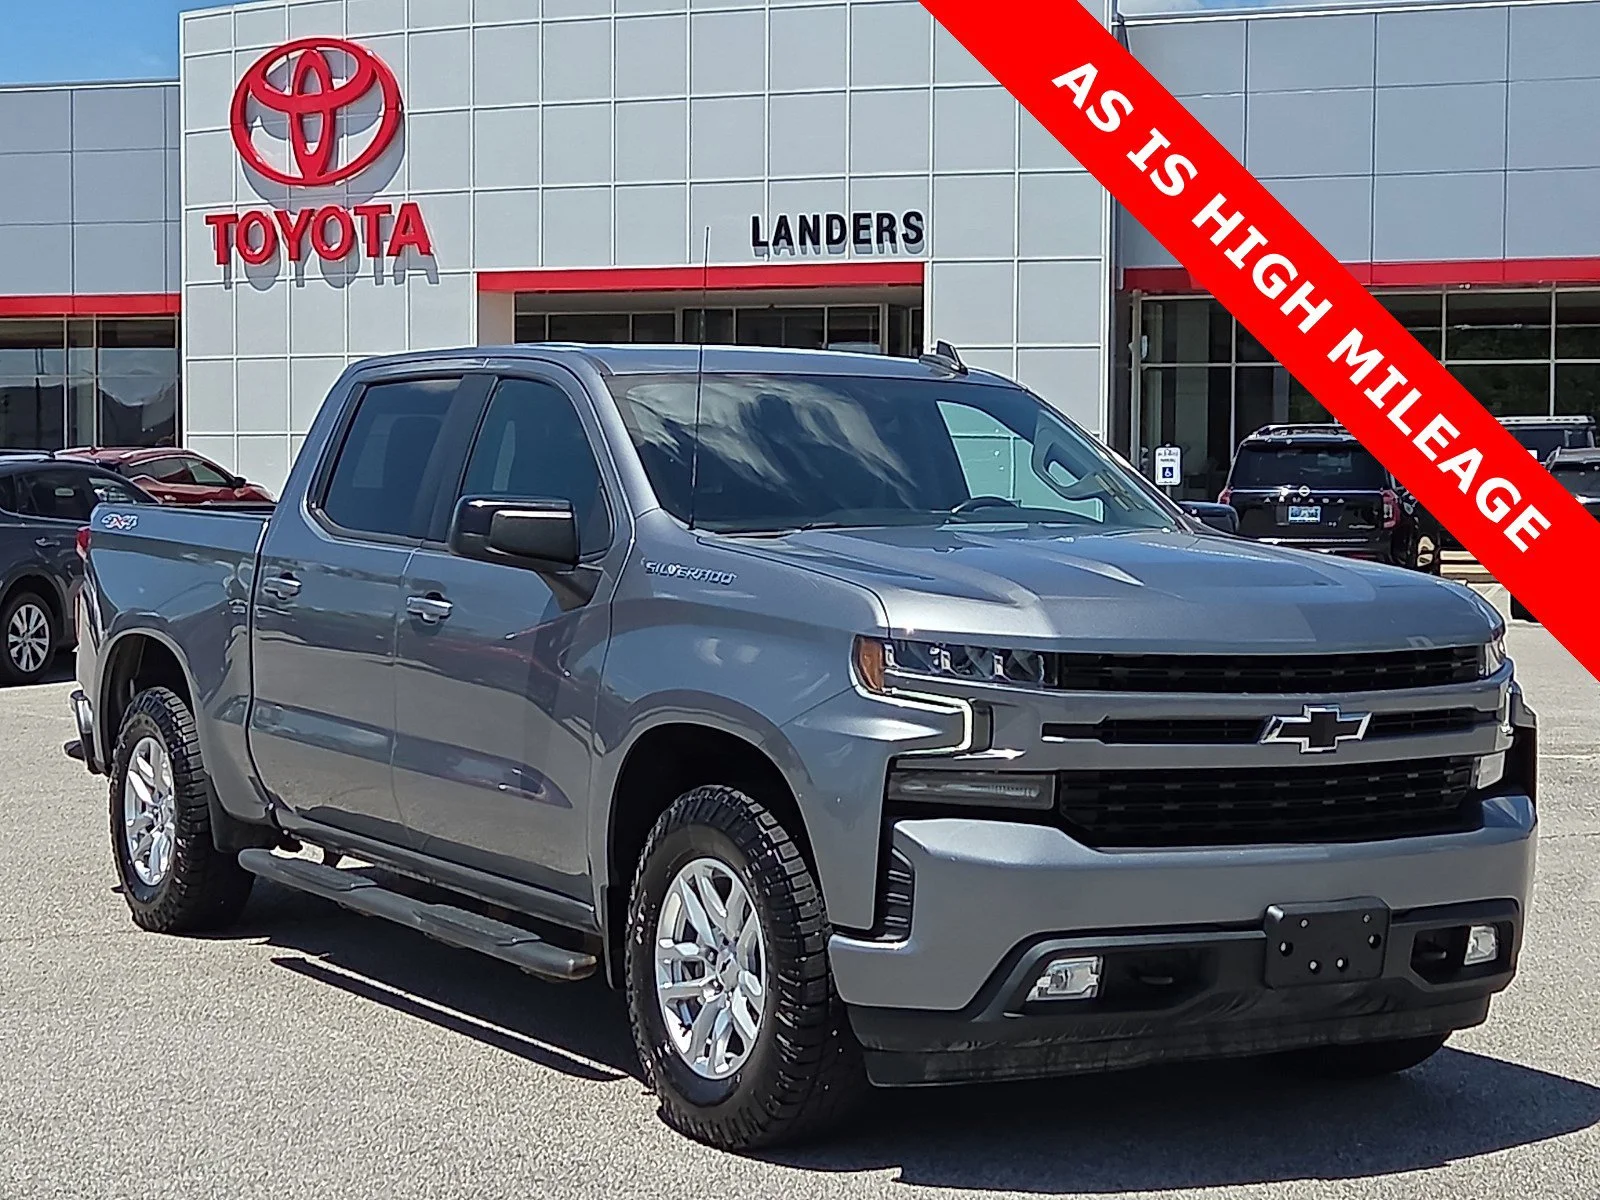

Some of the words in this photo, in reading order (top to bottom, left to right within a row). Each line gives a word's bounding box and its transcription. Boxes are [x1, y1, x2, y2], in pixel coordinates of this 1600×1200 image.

[205, 203, 434, 265] TOYOTA
[752, 211, 924, 248] LANDERS
[645, 561, 738, 584] SILVERADO
